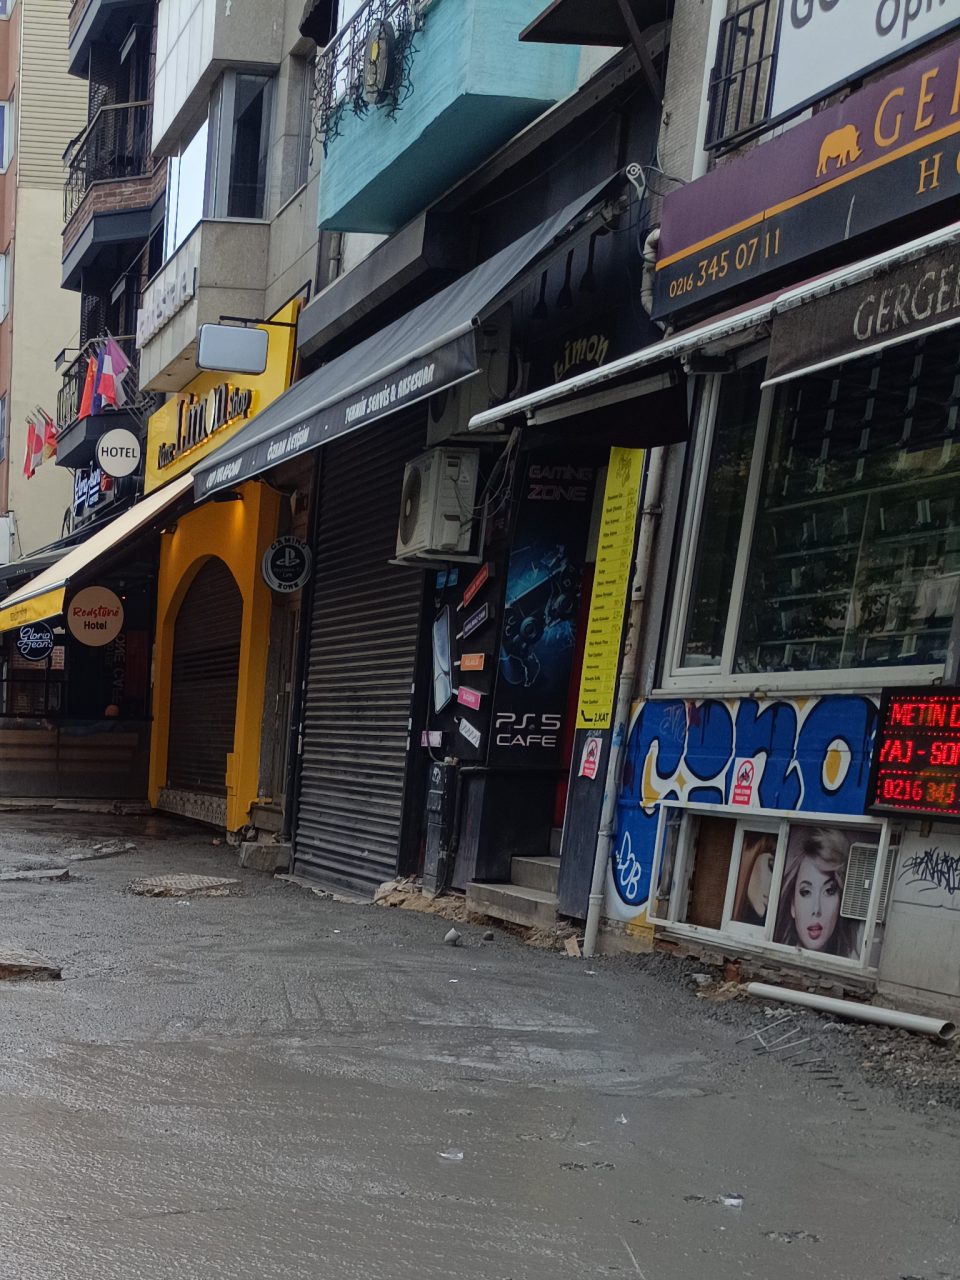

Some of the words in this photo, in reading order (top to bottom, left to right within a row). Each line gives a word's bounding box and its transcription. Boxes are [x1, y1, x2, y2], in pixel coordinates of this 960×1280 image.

[874, 57, 960, 147] GE
[669, 274, 693, 298] 0216
[696, 249, 730, 287] 345
[735, 236, 758, 270] 07
[763, 227, 781, 259] 11
[852, 262, 960, 341] GERGE
[102, 446, 138, 458] HOTEL
[20, 627, 51, 642] Gloria
[84, 621, 107, 630] Hotel
[890, 700, 947, 727] METİN
[496, 734, 558, 747] CAFE
[883, 779, 922, 800] 0216
[926, 782, 957, 804] 345
